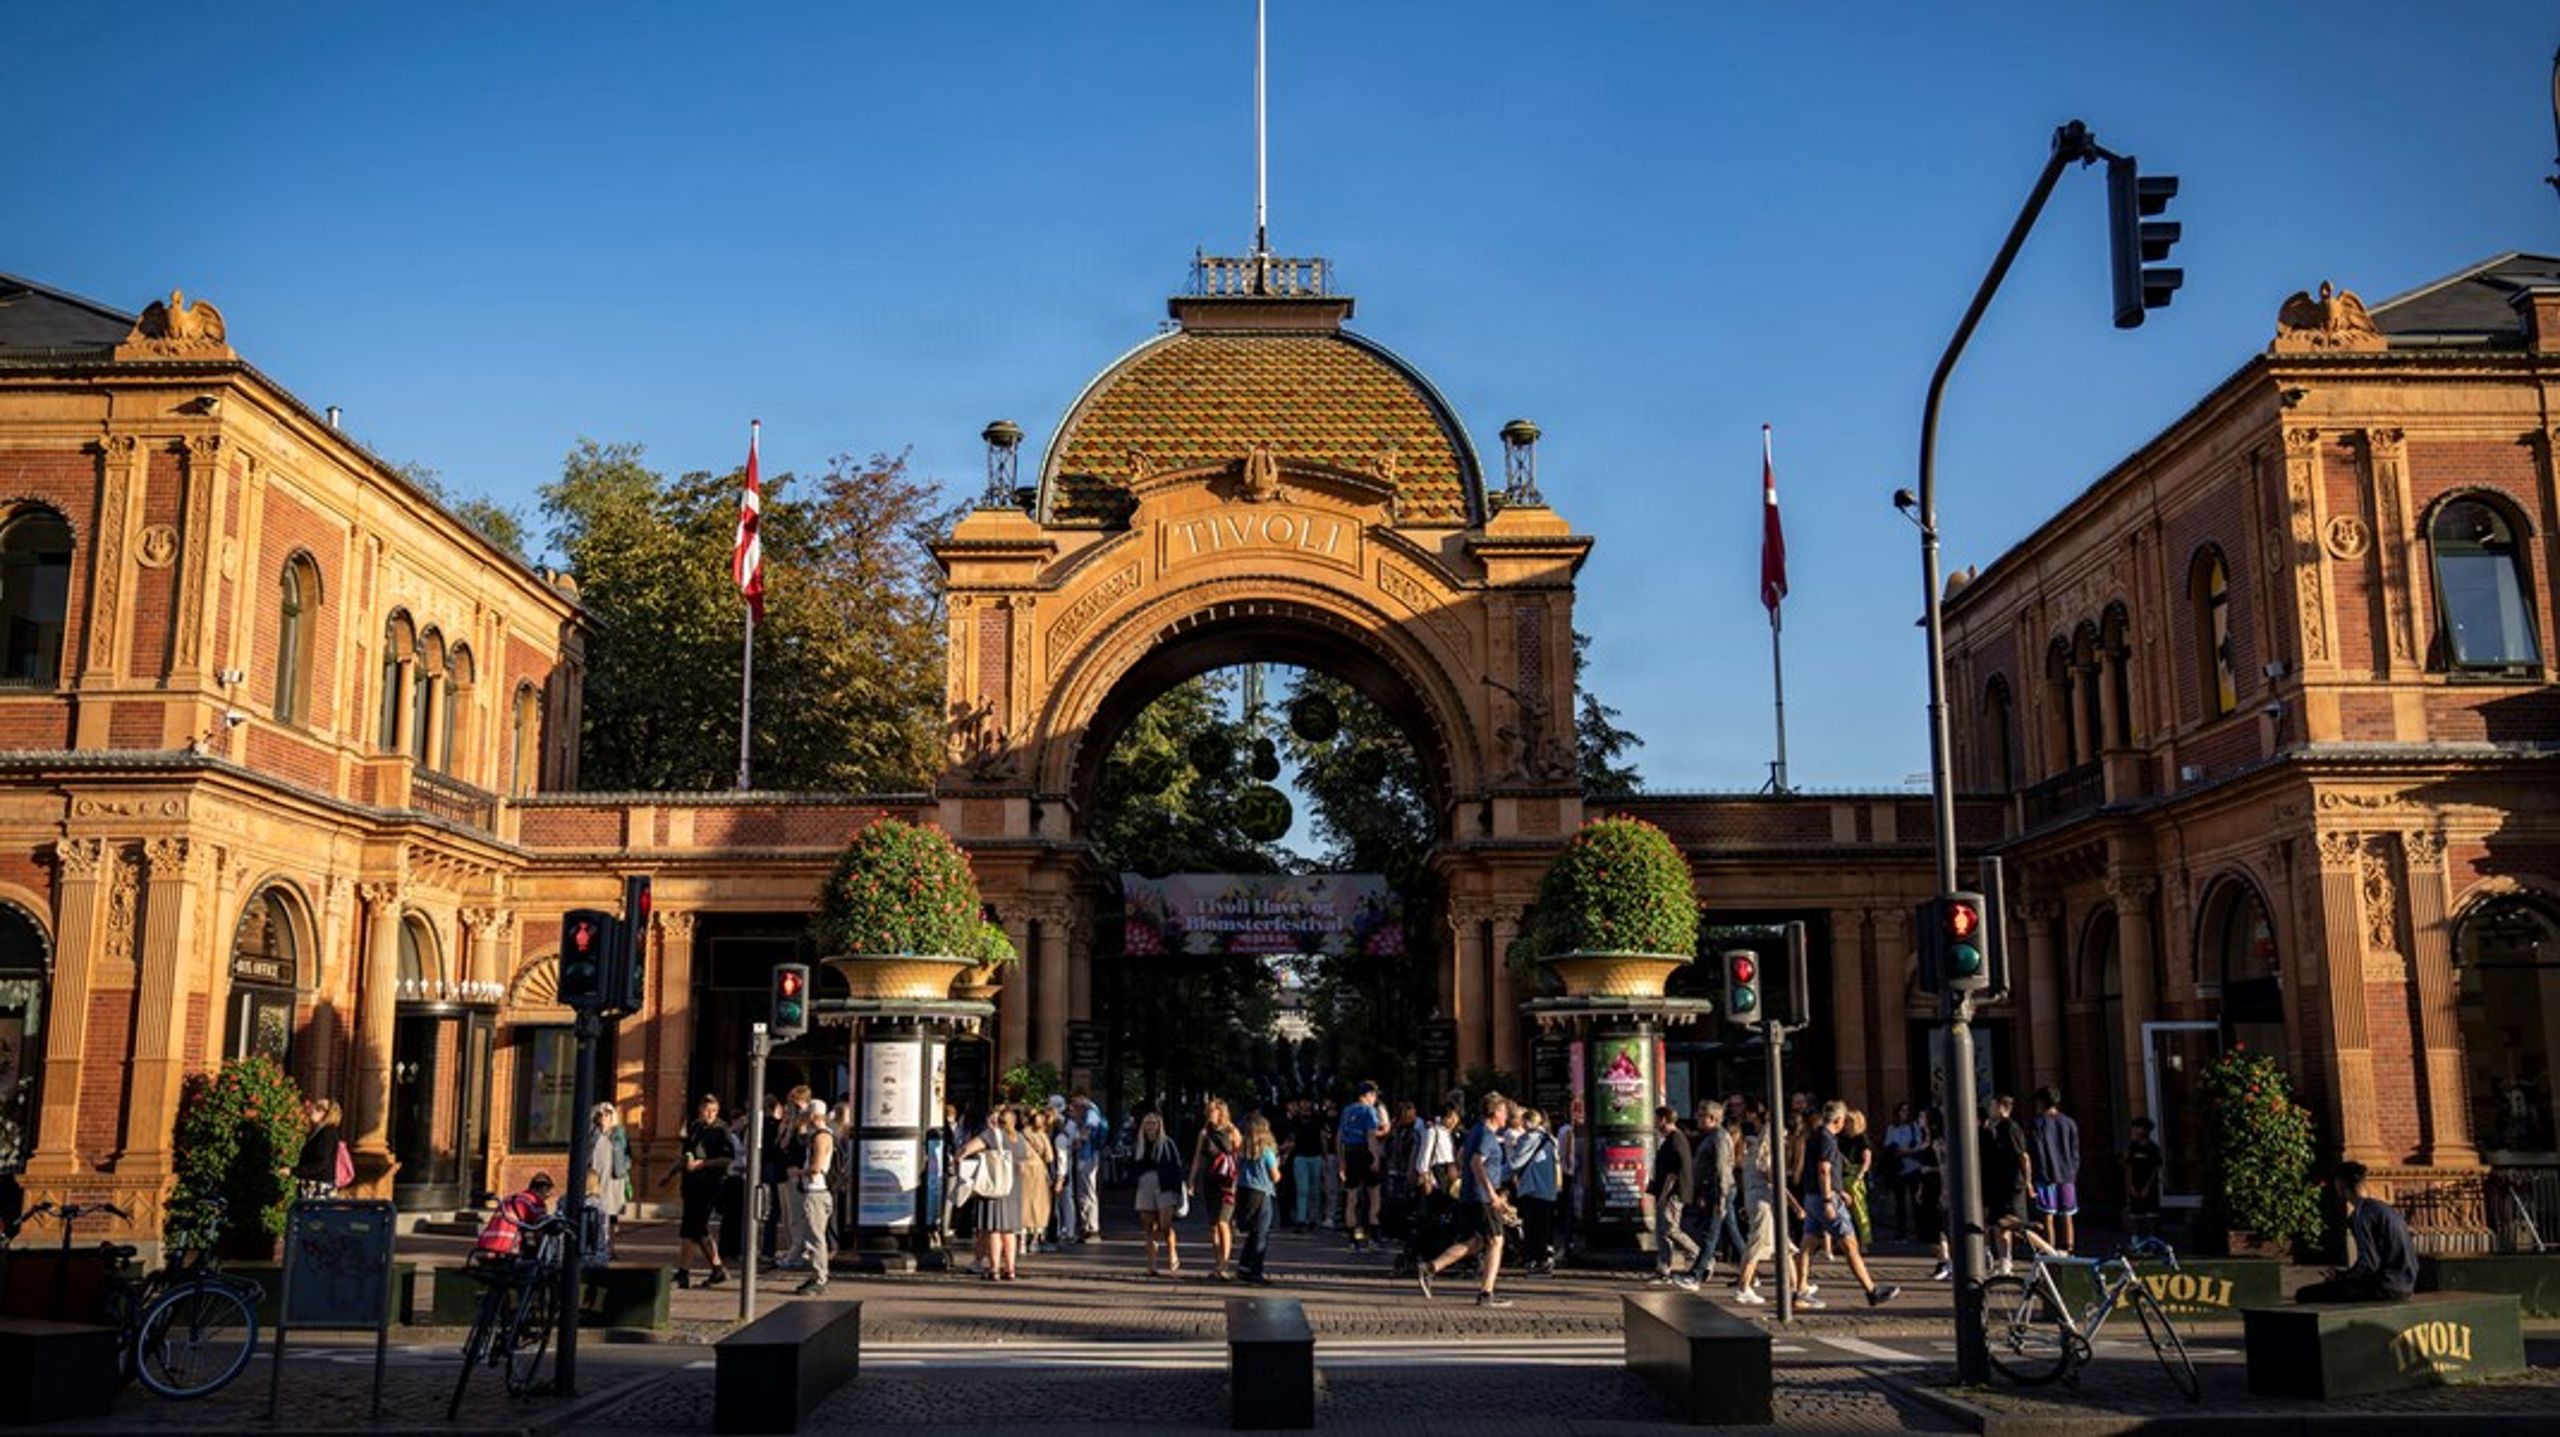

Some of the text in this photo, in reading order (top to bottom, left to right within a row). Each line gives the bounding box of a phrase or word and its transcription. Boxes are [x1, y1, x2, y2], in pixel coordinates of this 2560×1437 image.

[1174, 512, 1342, 556] TIVOLI
[1197, 898, 1250, 914] Tivoli
[1310, 902, 1335, 917] og
[1186, 914, 1344, 931] Blomsterfestival
[253, 962, 279, 979] OFFICE
[2388, 1316, 2473, 1373] TIVOLI
